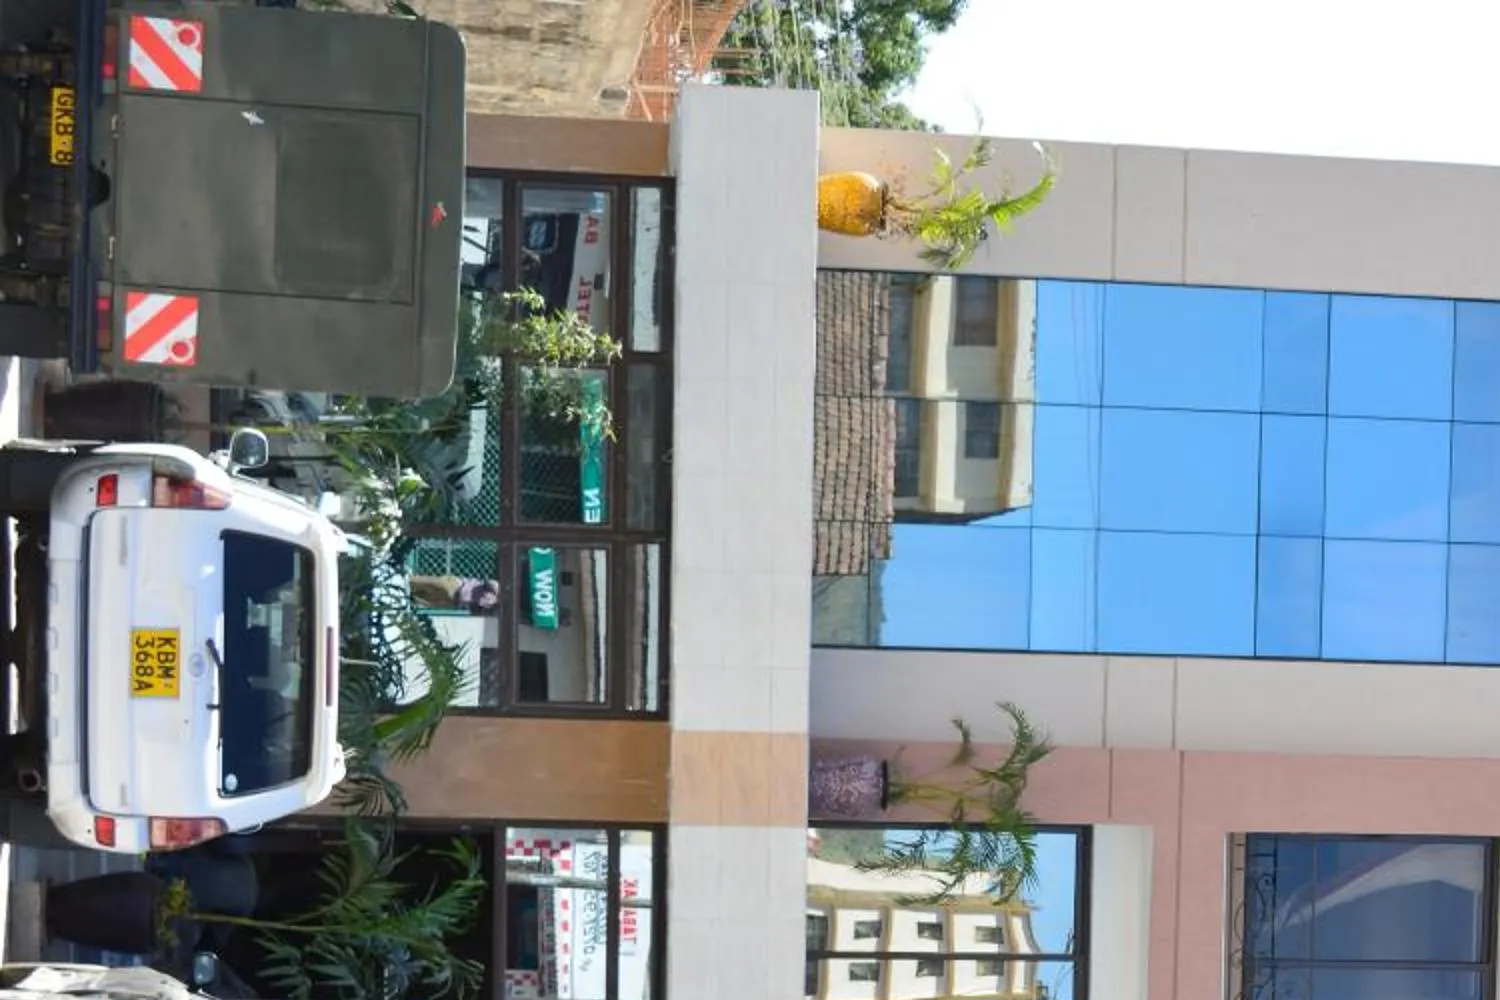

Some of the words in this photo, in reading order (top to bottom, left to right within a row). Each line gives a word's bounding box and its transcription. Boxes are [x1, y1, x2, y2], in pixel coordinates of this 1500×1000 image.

[55, 92, 76, 137] GKB
[133, 634, 155, 693] 368A
[156, 636, 177, 680] KBM
